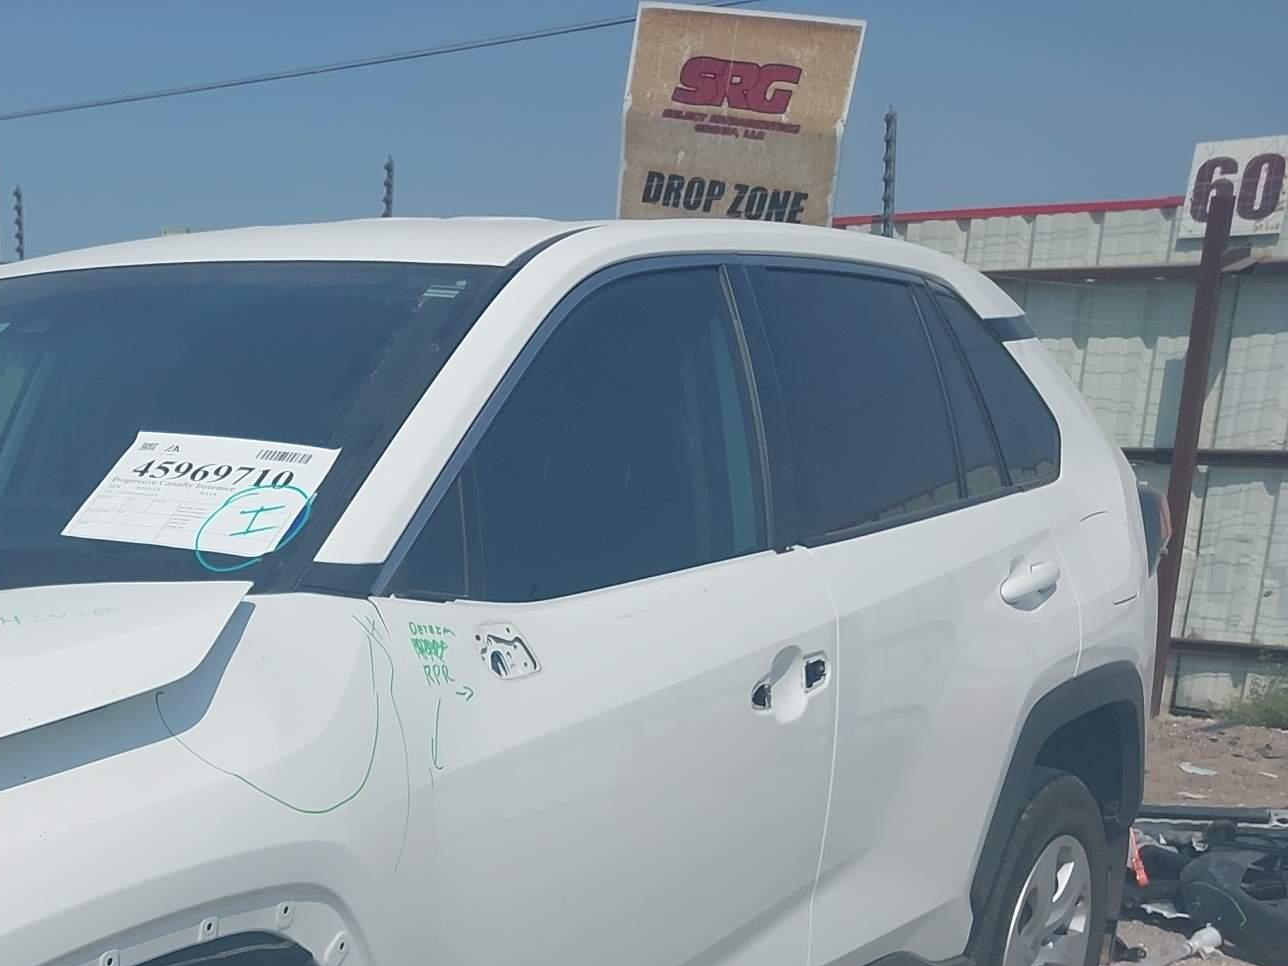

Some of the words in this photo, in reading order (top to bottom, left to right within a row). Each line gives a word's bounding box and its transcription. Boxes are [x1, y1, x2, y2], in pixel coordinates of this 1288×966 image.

[671, 56, 802, 114] SRG
[641, 170, 726, 213] DROP
[726, 183, 809, 224] ZONE
[1190, 153, 1286, 223] 60
[133, 459, 294, 490] 45969710
